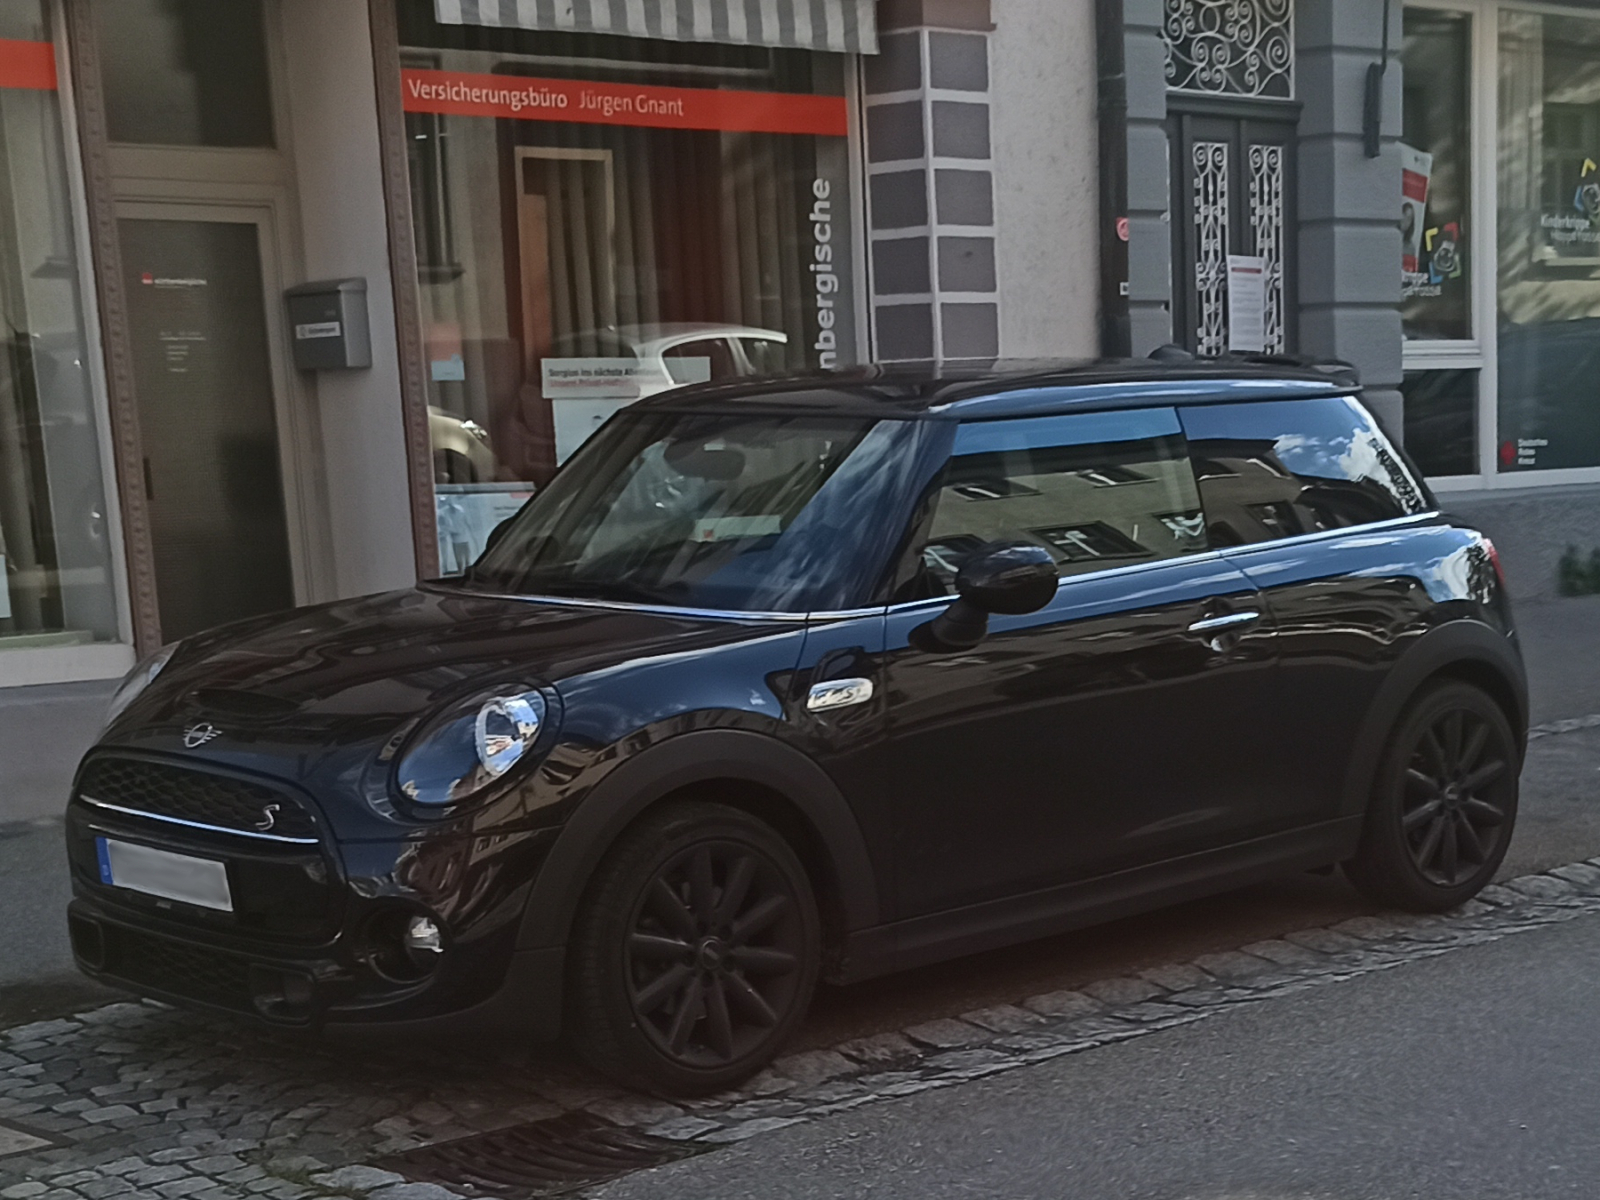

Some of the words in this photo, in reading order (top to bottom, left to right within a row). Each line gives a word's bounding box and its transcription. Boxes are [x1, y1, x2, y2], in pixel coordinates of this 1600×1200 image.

[408, 79, 568, 111] Versicherungsbüro
[579, 90, 633, 116] Jürgen
[635, 94, 684, 116] Gnant
[255, 804, 280, 831] S
